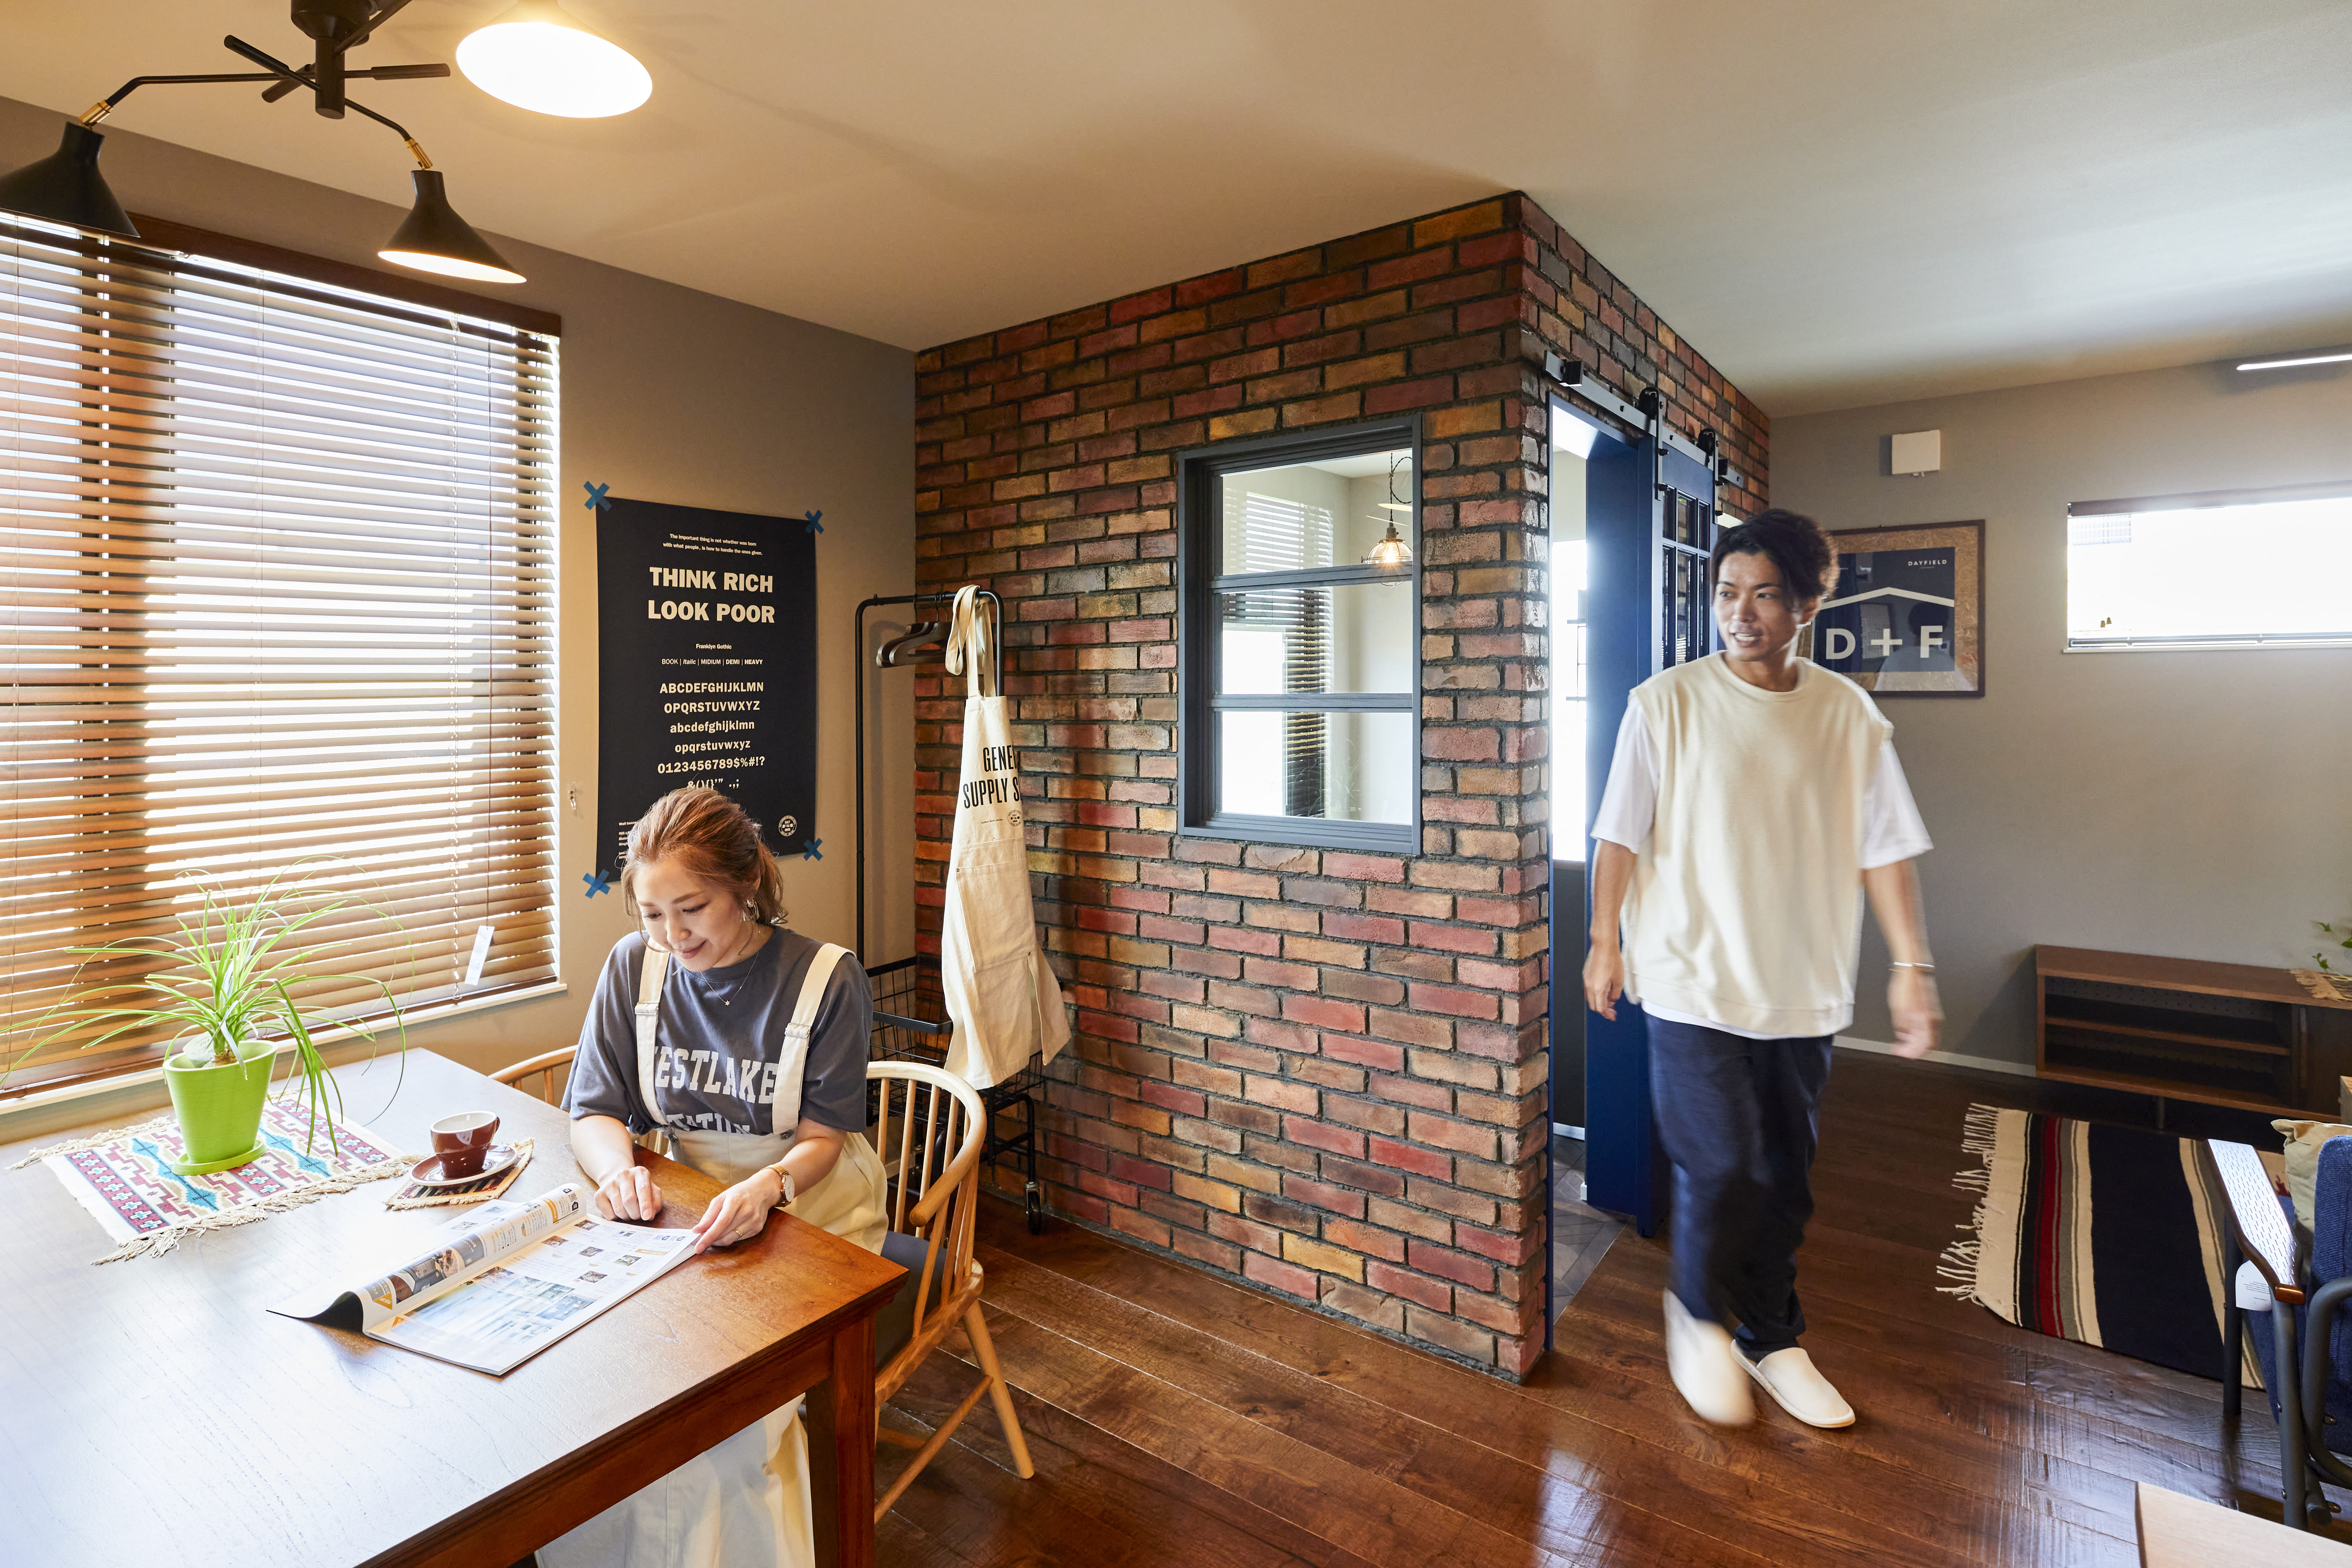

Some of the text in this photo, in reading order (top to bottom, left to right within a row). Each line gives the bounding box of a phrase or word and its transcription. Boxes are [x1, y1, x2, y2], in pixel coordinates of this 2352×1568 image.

[649, 567, 773, 593] THINK RICH
[648, 600, 775, 623] LOOK POOR
[1826, 628, 1856, 659] D
[1920, 625, 1943, 658] F
[660, 682, 764, 694] ABCDEFGHIJKLMN
[664, 701, 760, 714] OPQRSTUVWXYZ
[670, 720, 754, 733] abcdefghijklmn
[675, 741, 751, 754] opqrstuvwxyz
[658, 756, 765, 774] 0123456789$%#!?
[963, 776, 1022, 809] SUPPLY S
[654, 1046, 779, 1104] ESTLAKE
[666, 1113, 751, 1134] TATIN
